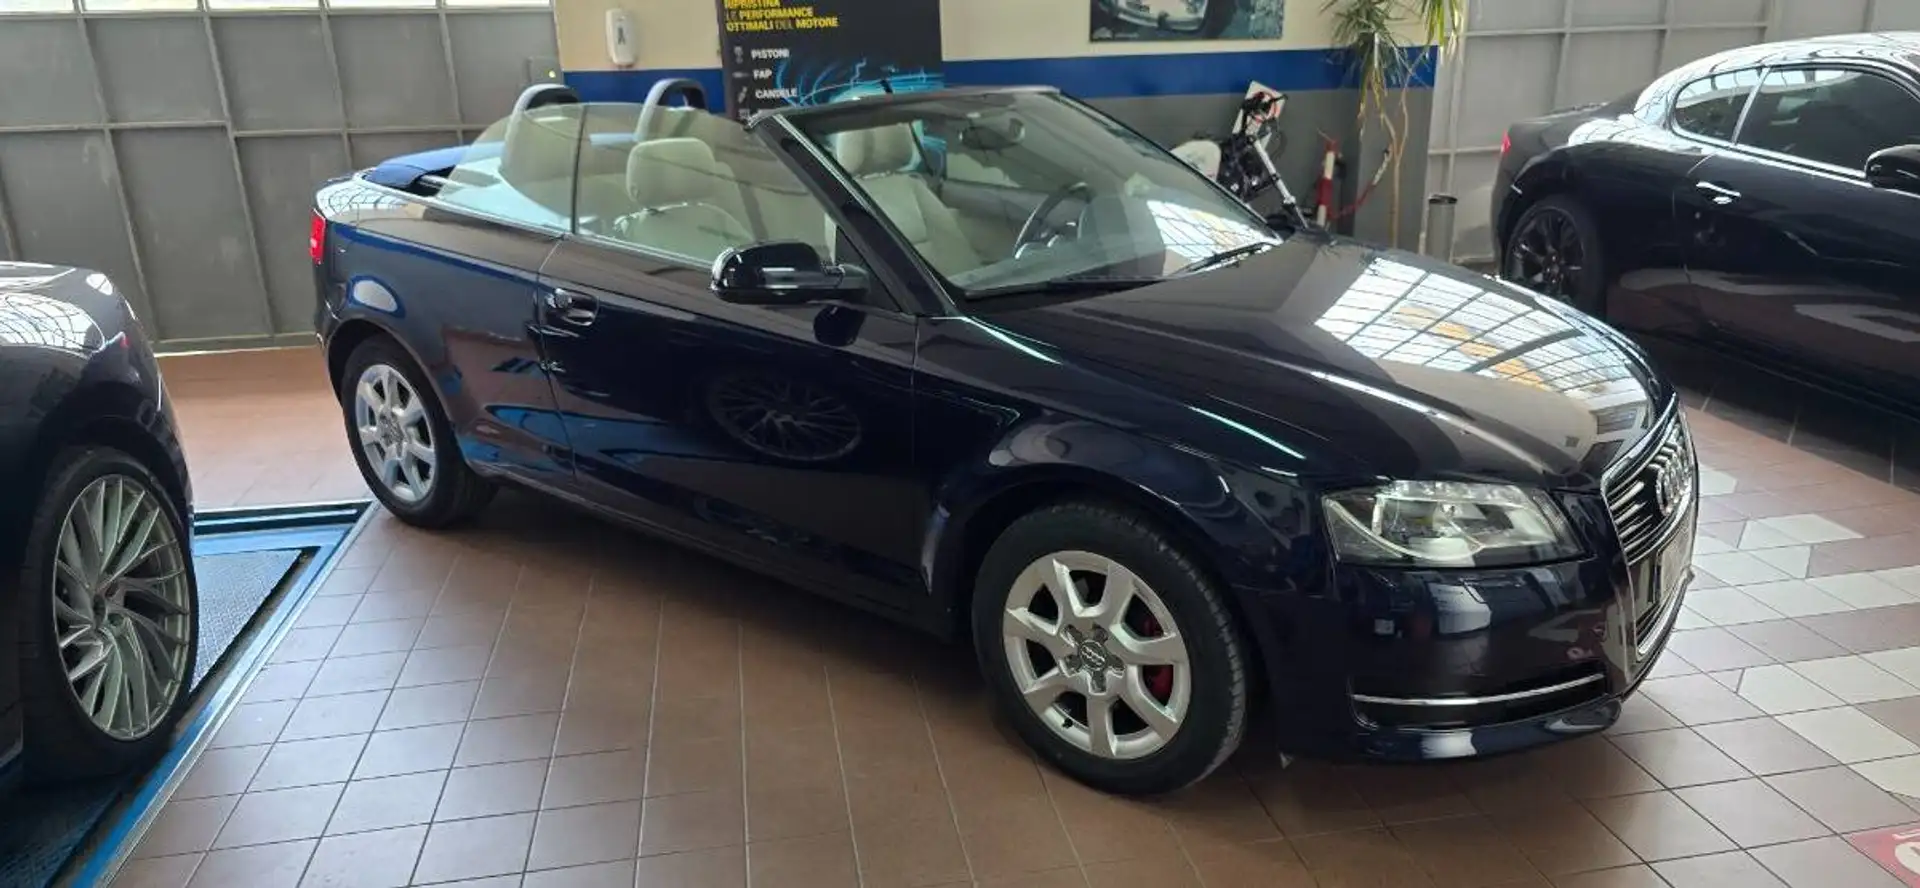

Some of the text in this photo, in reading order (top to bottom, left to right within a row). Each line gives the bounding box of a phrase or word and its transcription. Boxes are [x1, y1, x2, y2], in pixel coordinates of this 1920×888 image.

[739, 7, 813, 20] PERFORMANCE
[726, 20, 774, 31] OTTIMALI
[795, 17, 839, 29] MOTORE
[751, 49, 790, 59] PISTONI
[753, 69, 773, 80] FAP
[755, 88, 798, 99] CANDELE
